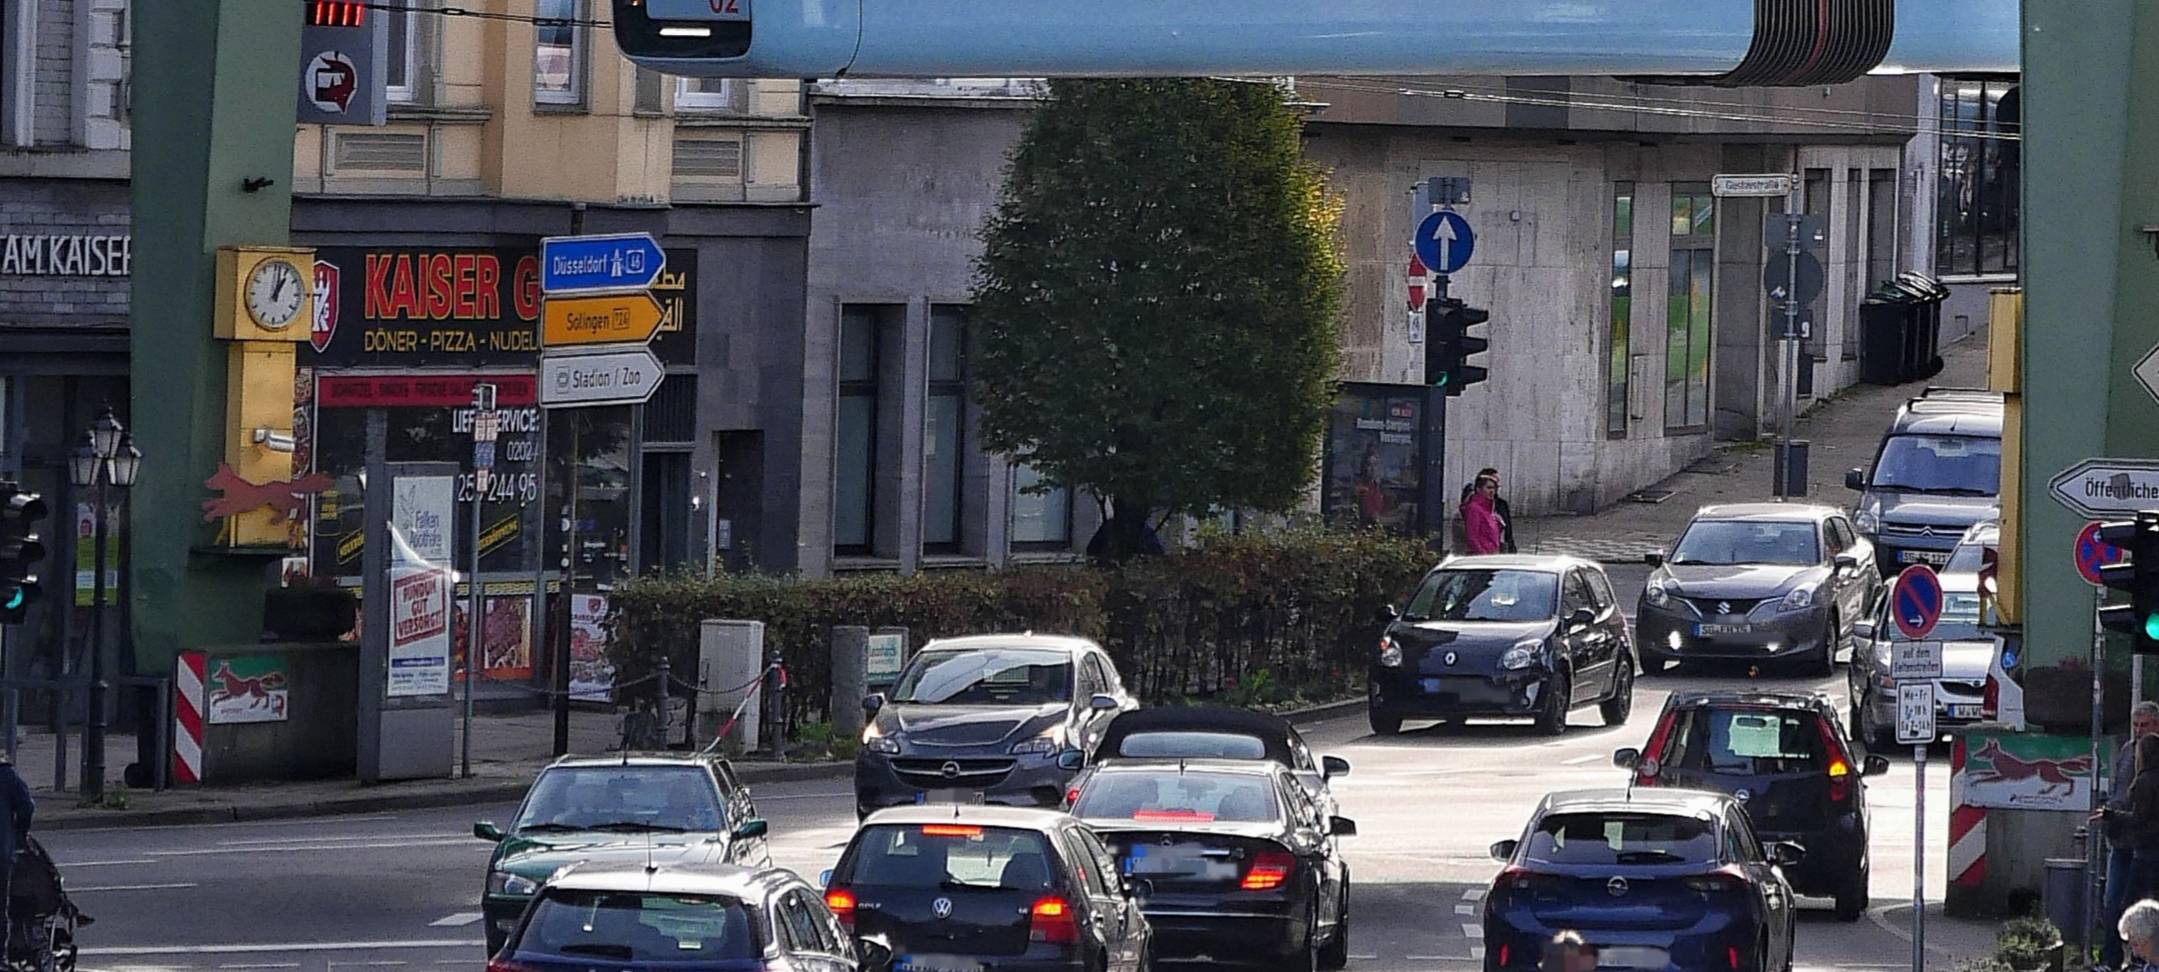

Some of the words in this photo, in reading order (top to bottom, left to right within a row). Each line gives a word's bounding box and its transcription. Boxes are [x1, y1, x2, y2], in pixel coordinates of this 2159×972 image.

[553, 254, 608, 276] Düsseldorf
[364, 253, 500, 320] KAISER
[566, 312, 609, 333] Solingen
[364, 328, 418, 352] DÖNER
[430, 331, 476, 352] PIZZA
[572, 370, 610, 390] Stadion
[622, 367, 641, 386] Zoo
[453, 409, 540, 433] LIEFERVICE:
[488, 473, 515, 501] 244
[518, 473, 537, 501] 95
[411, 598, 428, 616] GUT
[1903, 648, 1914, 659] auf
[1916, 649, 1930, 658] dem
